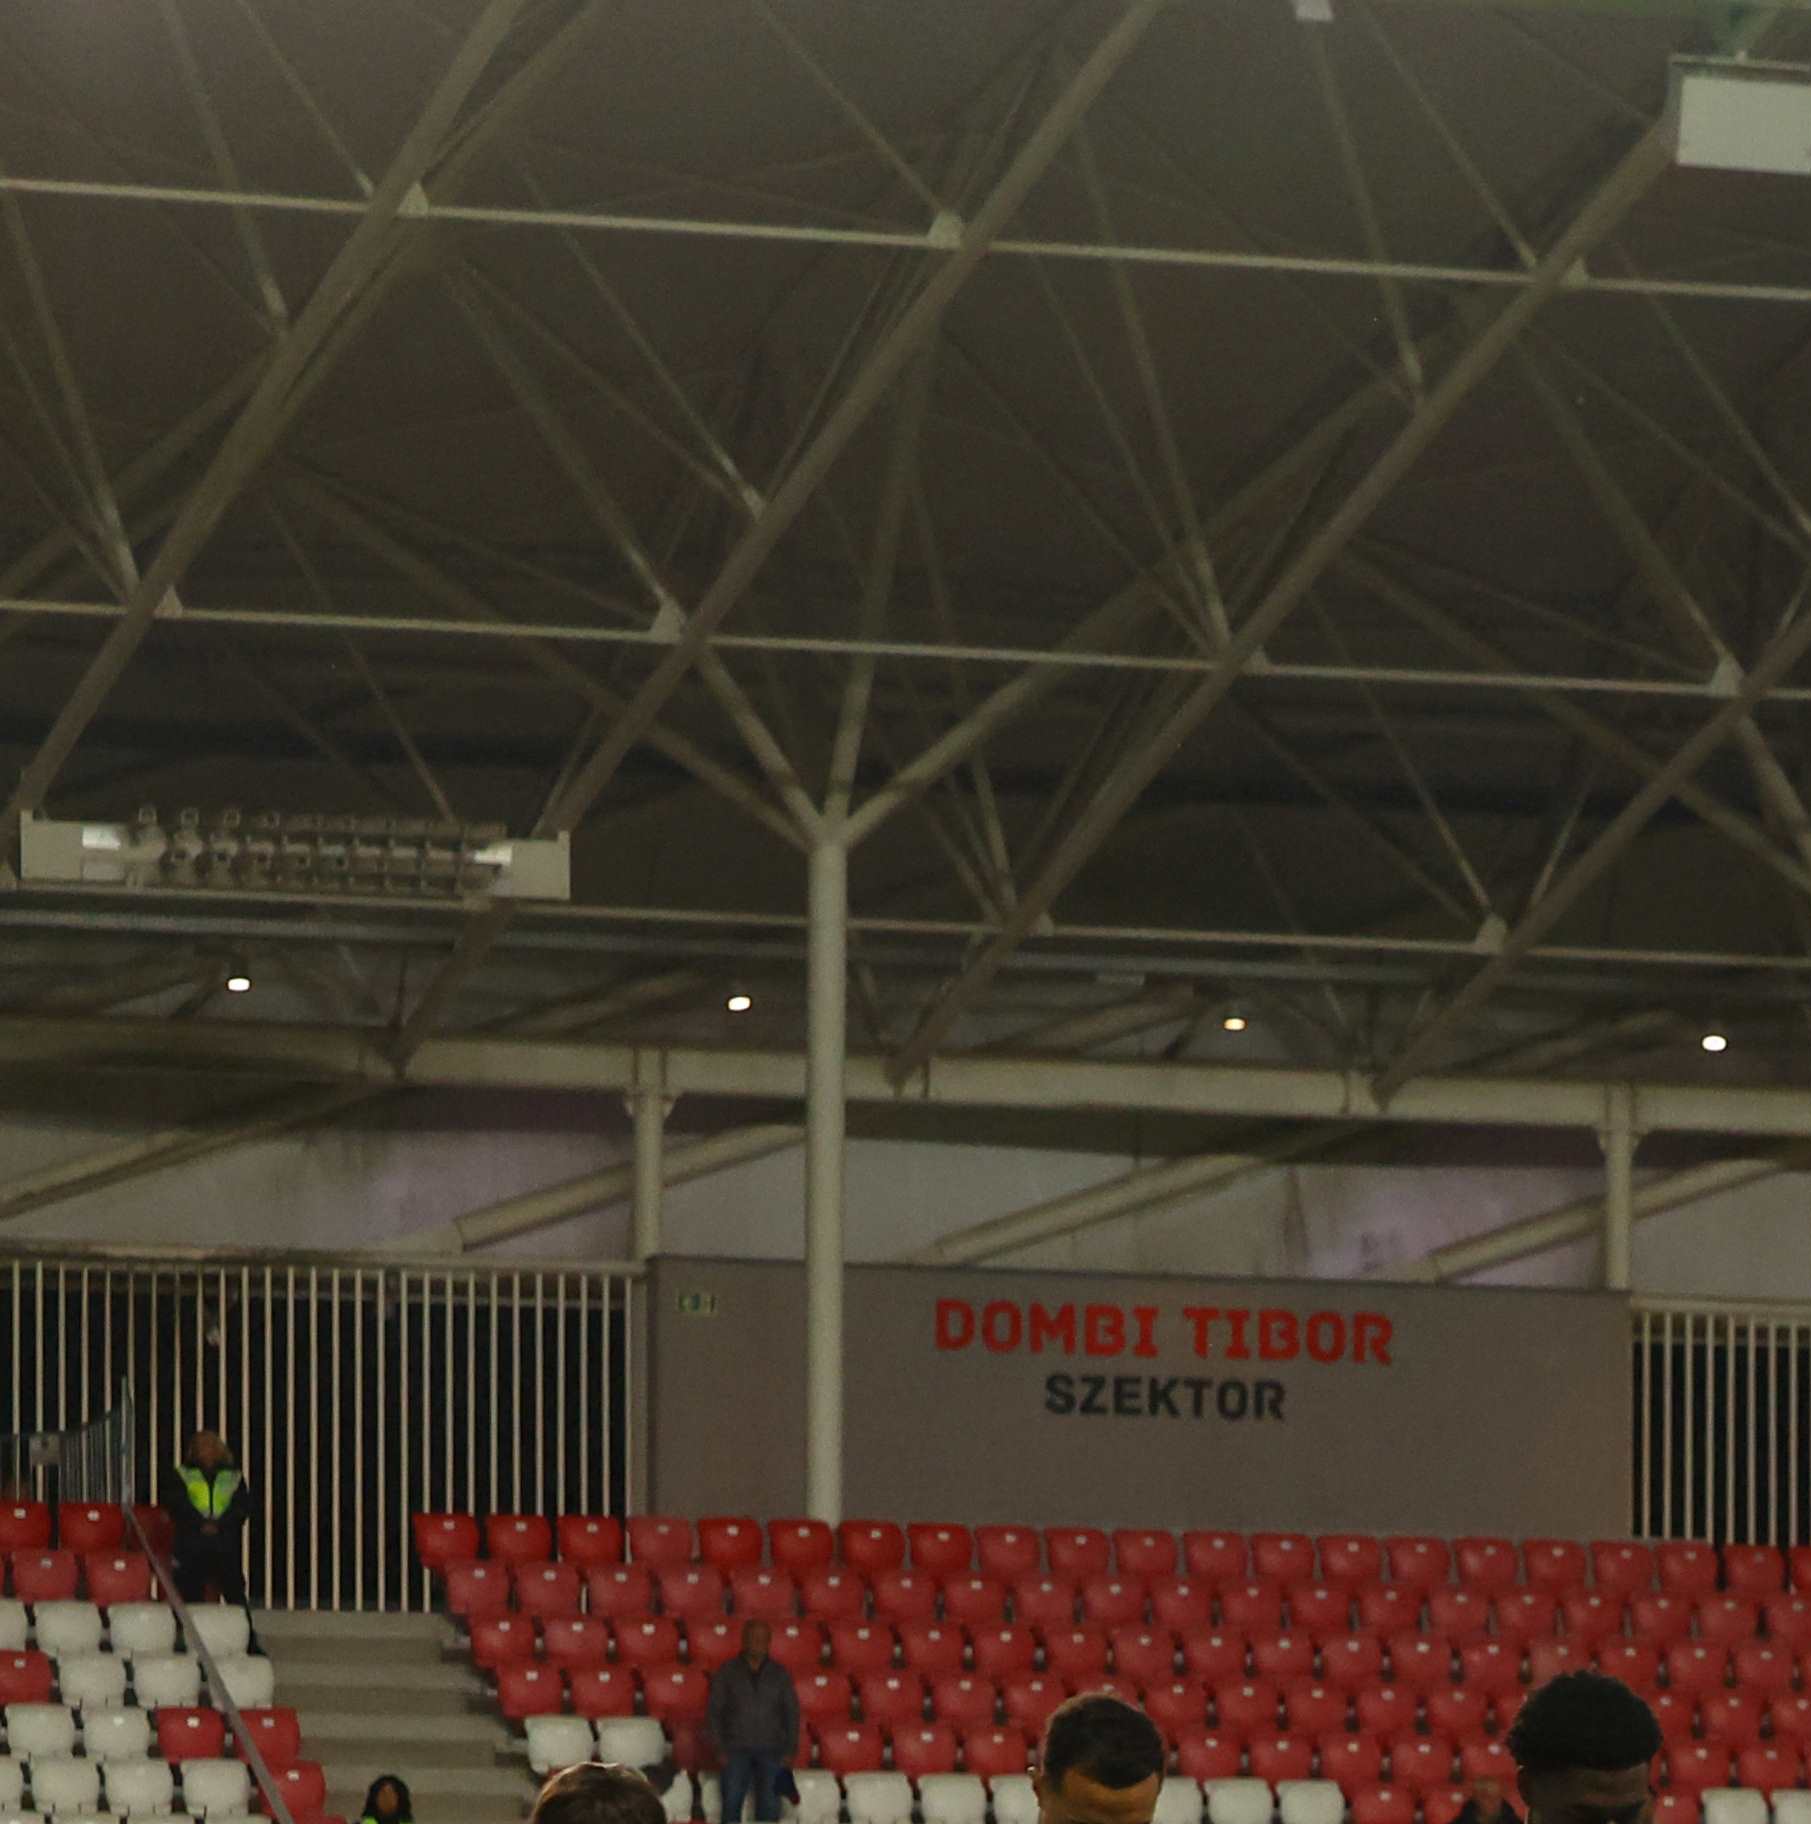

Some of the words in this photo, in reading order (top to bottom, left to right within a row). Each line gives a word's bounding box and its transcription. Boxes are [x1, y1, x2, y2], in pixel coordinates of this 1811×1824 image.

[934, 1298, 1159, 1357] DOMBI
[1183, 1306, 1392, 1365] TIBOR
[1044, 1373, 1286, 1421] SZEKTOR
